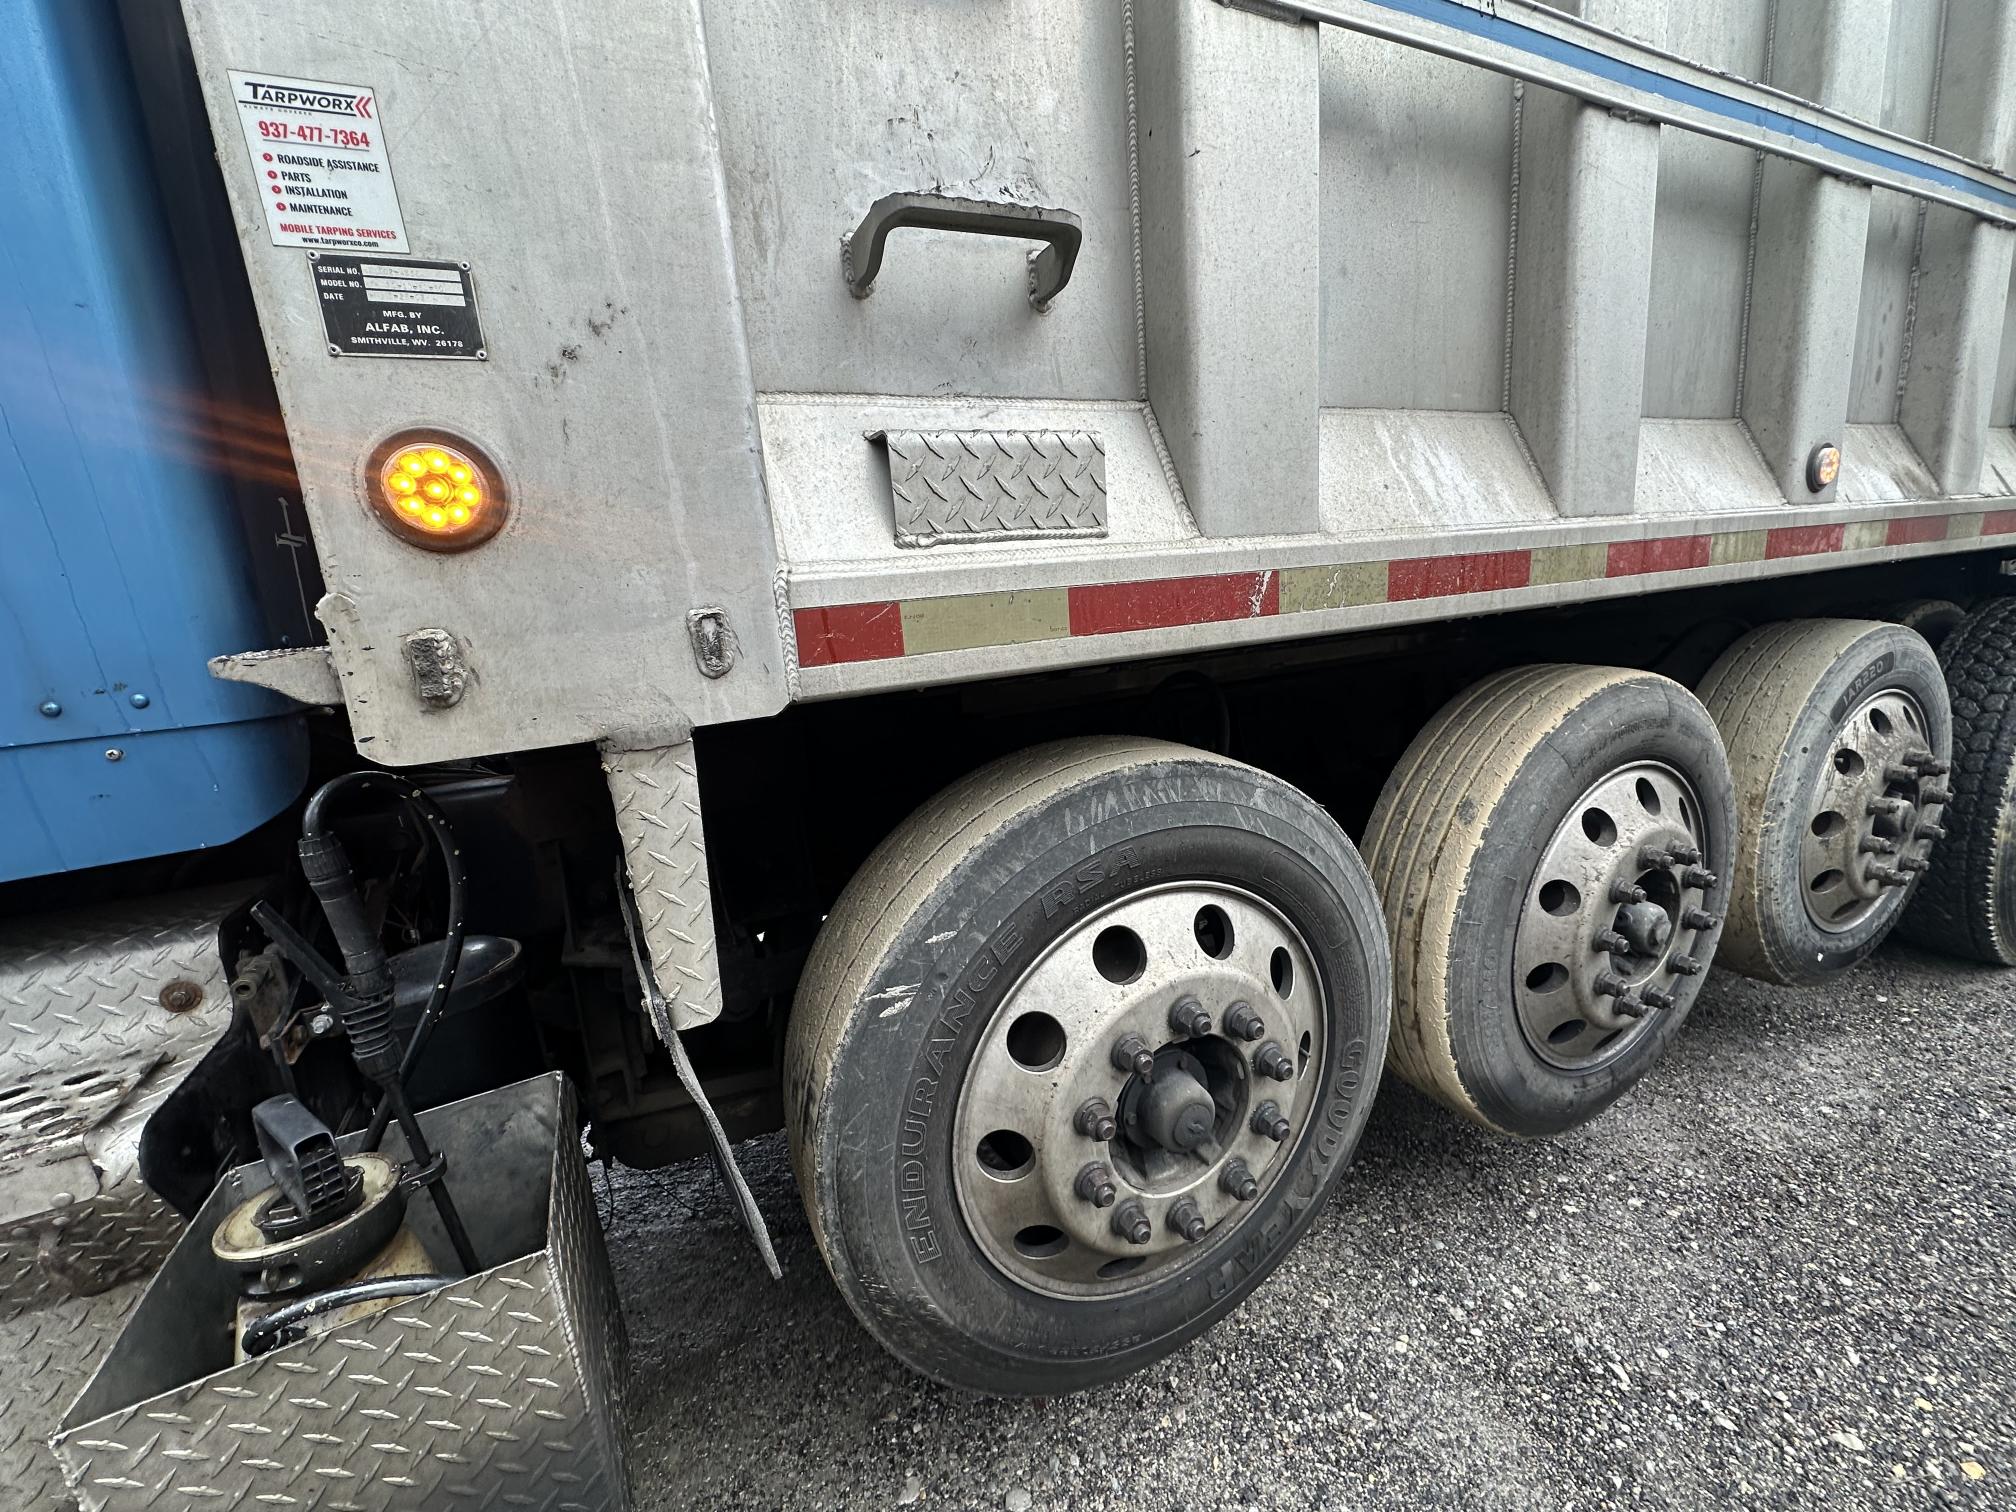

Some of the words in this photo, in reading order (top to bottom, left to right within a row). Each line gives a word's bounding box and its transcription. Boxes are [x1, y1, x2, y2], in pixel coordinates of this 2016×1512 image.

[244, 82, 355, 112] TARPWORX
[258, 120, 370, 147] 937-477-7364
[277, 153, 325, 168] ROADSIDE
[327, 159, 380, 173] ASSISTANCE
[281, 171, 312, 183] PARTS
[285, 185, 348, 199] INSTALLATION
[289, 203, 354, 216] MAINTENANCE
[280, 223, 314, 234] MOBILE
[315, 226, 354, 237] TARPING
[356, 229, 397, 239] SERVICES
[302, 236, 379, 248] www.tarpworxco.com
[317, 266, 345, 274] SERIAL
[347, 267, 361, 275] NO.
[320, 279, 347, 288] MODEL
[349, 280, 363, 288] NO.
[323, 292, 344, 300] DATE
[382, 310, 407, 319] MFG.
[409, 311, 422, 319] BY
[365, 322, 413, 334] ALFAB,
[417, 325, 445, 335] INC.
[351, 336, 410, 346] SMITHVILLE,
[412, 338, 431, 347] WV.
[435, 340, 464, 348] 26178
[901, 922, 1025, 1264] ENDURANCE
[1041, 845, 1141, 920] RSA
